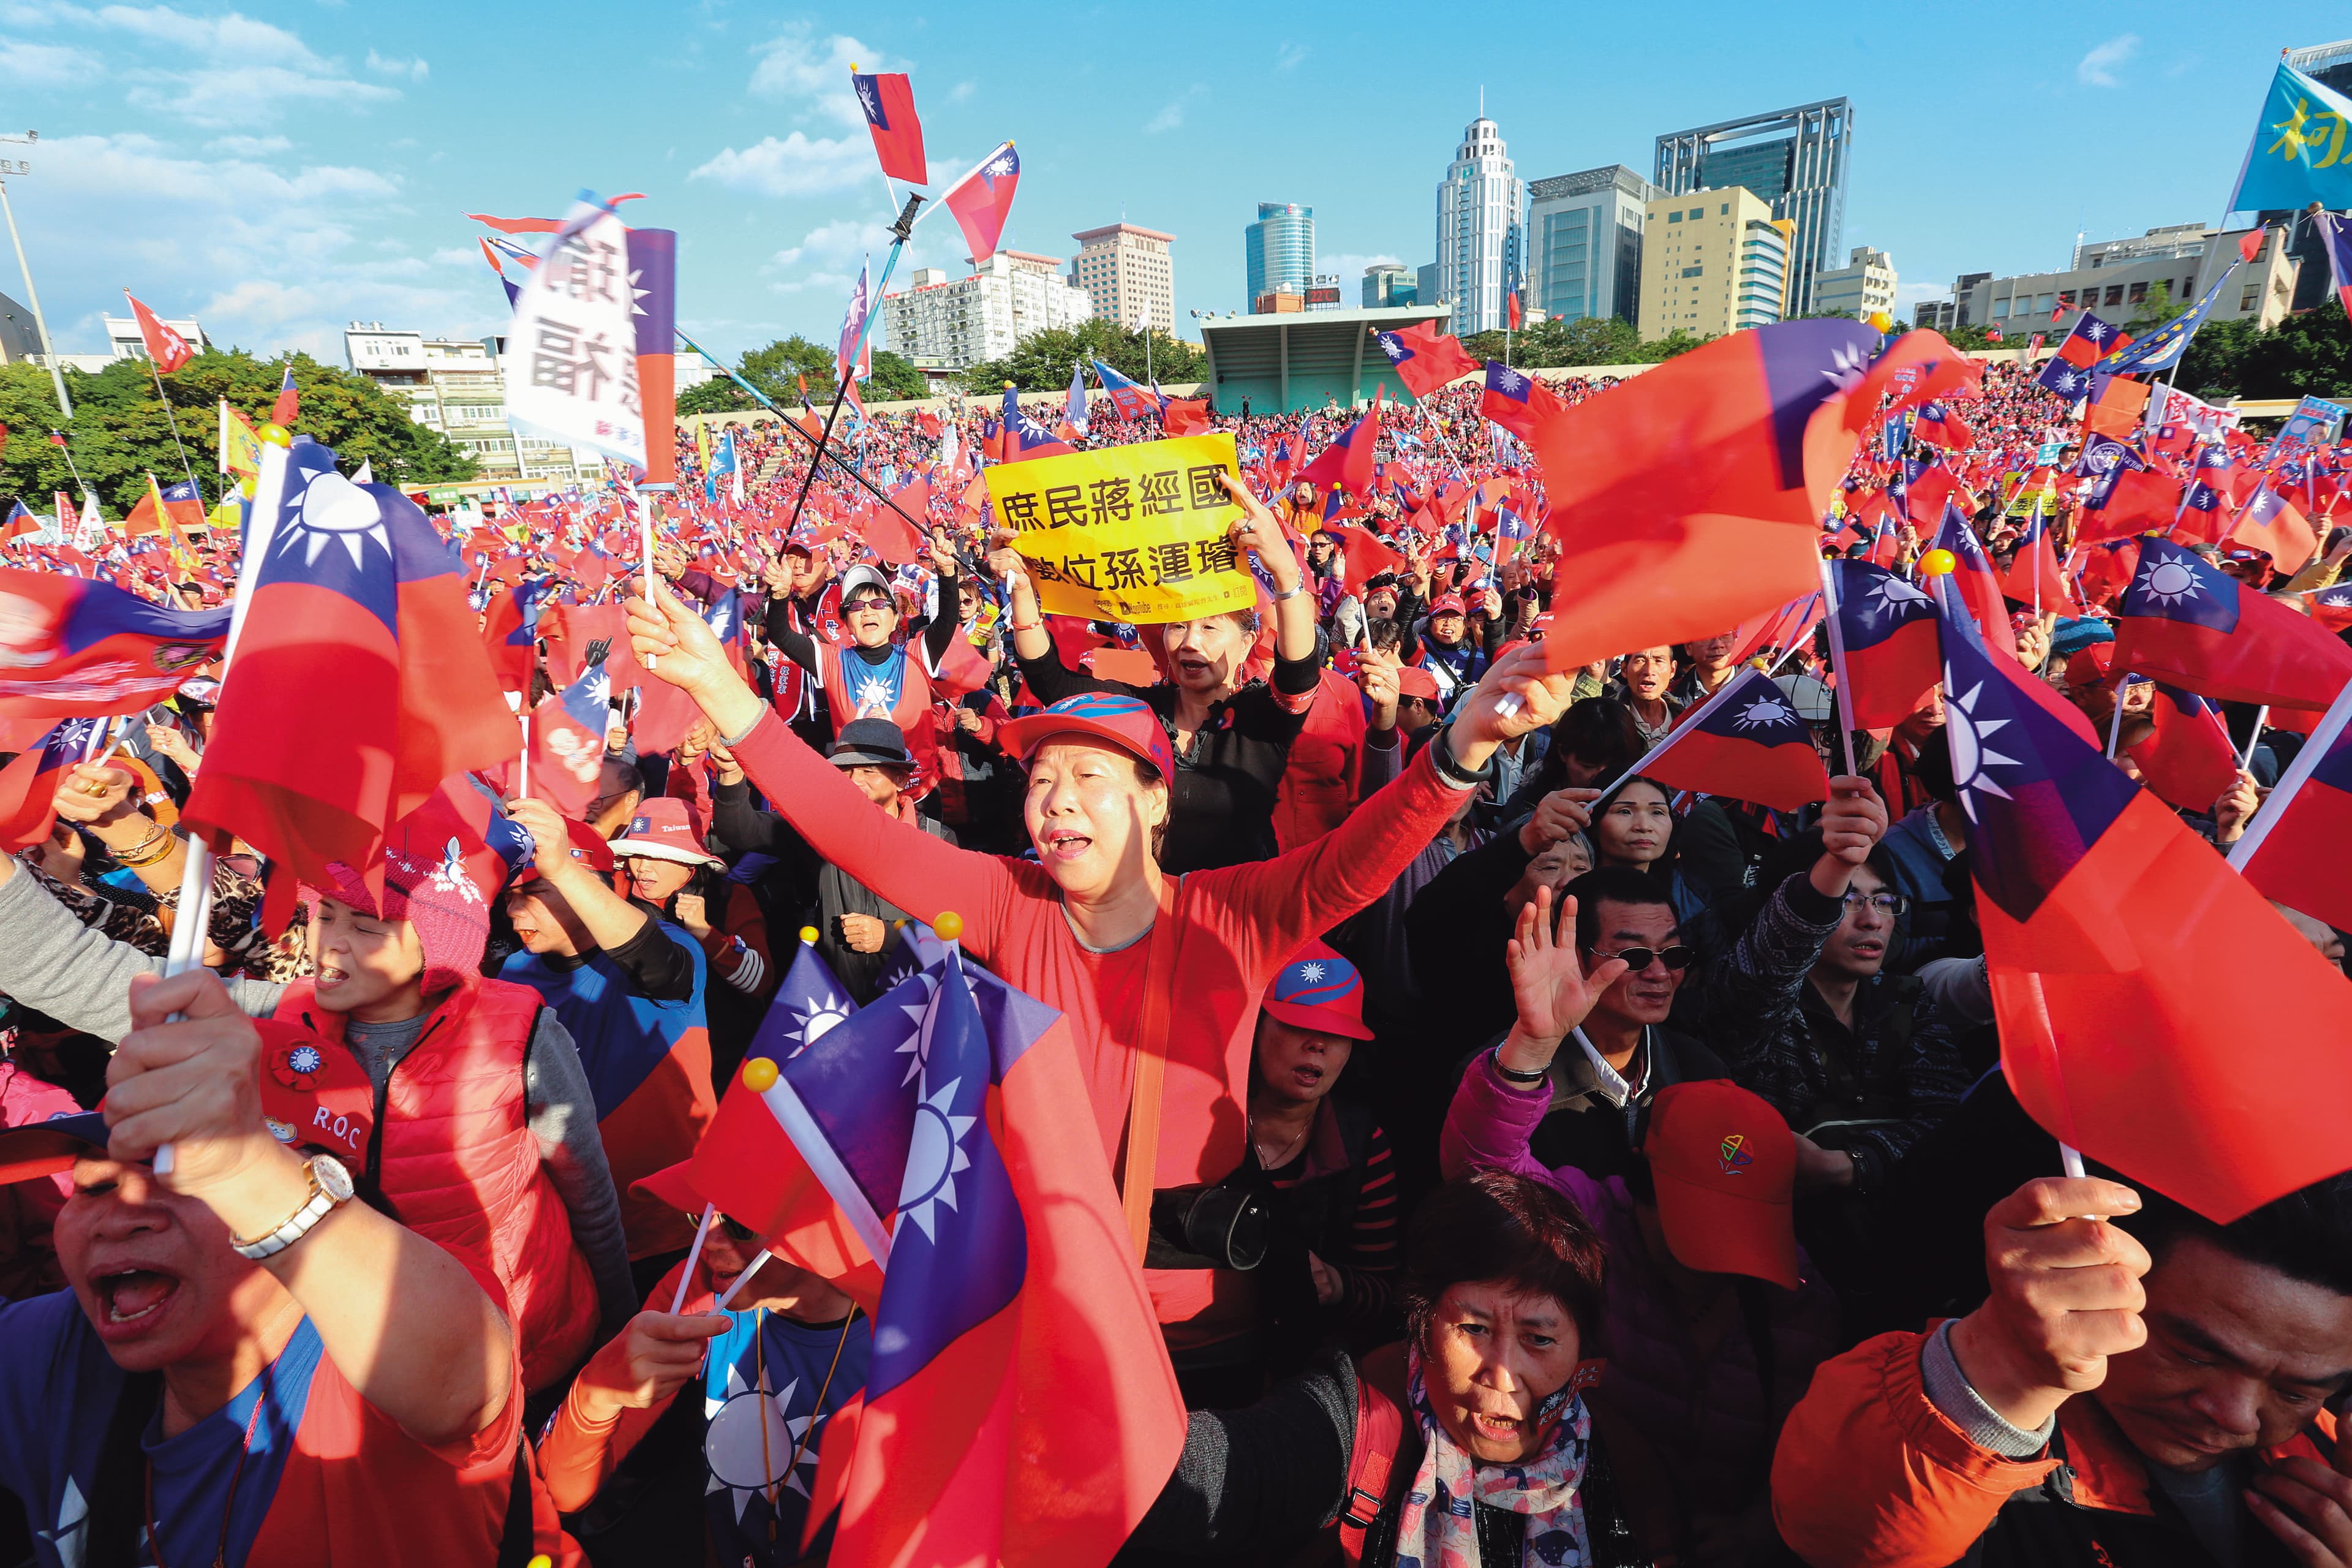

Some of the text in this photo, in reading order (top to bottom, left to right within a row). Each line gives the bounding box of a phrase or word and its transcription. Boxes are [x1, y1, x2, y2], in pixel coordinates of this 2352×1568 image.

[2267, 97, 2352, 169] 柯
[2165, 391, 2235, 428] 樹林
[1001, 463, 1232, 532] 庶民蔣經國
[777, 666, 791, 695] 韓家軍
[662, 824, 692, 832] Taiwan
